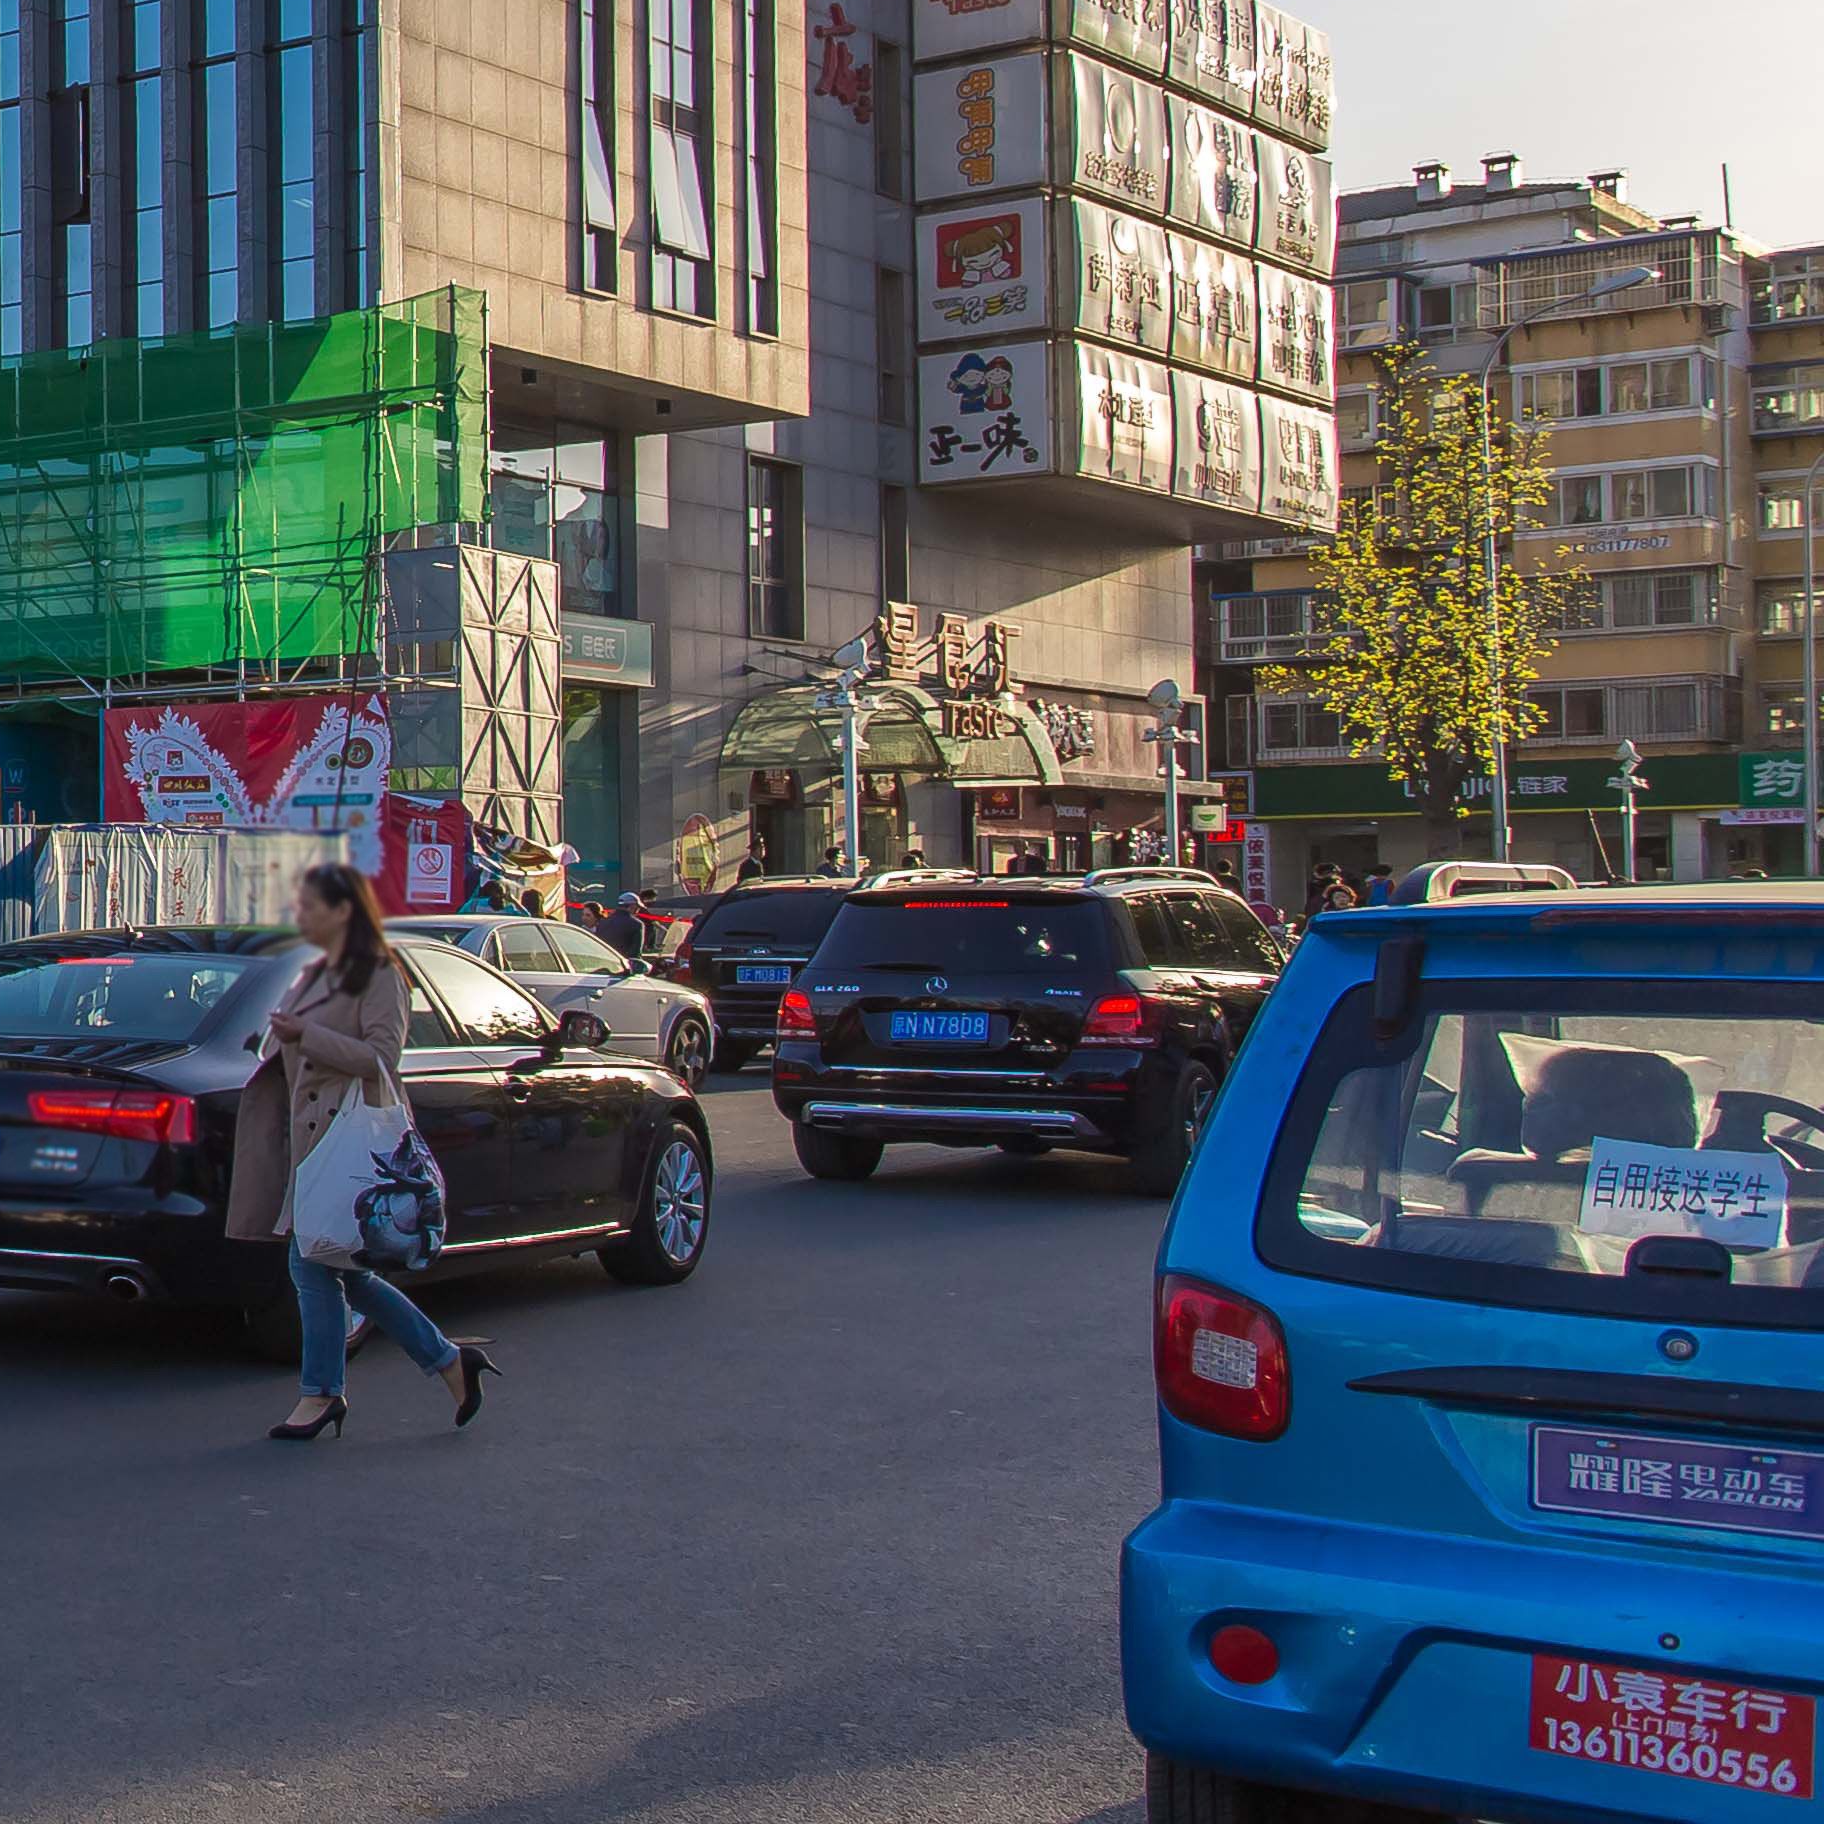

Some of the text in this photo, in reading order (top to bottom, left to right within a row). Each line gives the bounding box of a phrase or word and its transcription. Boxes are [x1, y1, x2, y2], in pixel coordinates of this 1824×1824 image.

[929, 412, 1029, 471] 正一味
[877, 601, 1026, 699] 星食汇
[944, 699, 1017, 739] Taste
[1518, 776, 1569, 795] 链家
[1753, 760, 1805, 797] 药
[1592, 1159, 1770, 1218] 自用接送学生
[1555, 1663, 1787, 1734] 小袁车行
[1544, 1717, 1798, 1793] 13611360556
